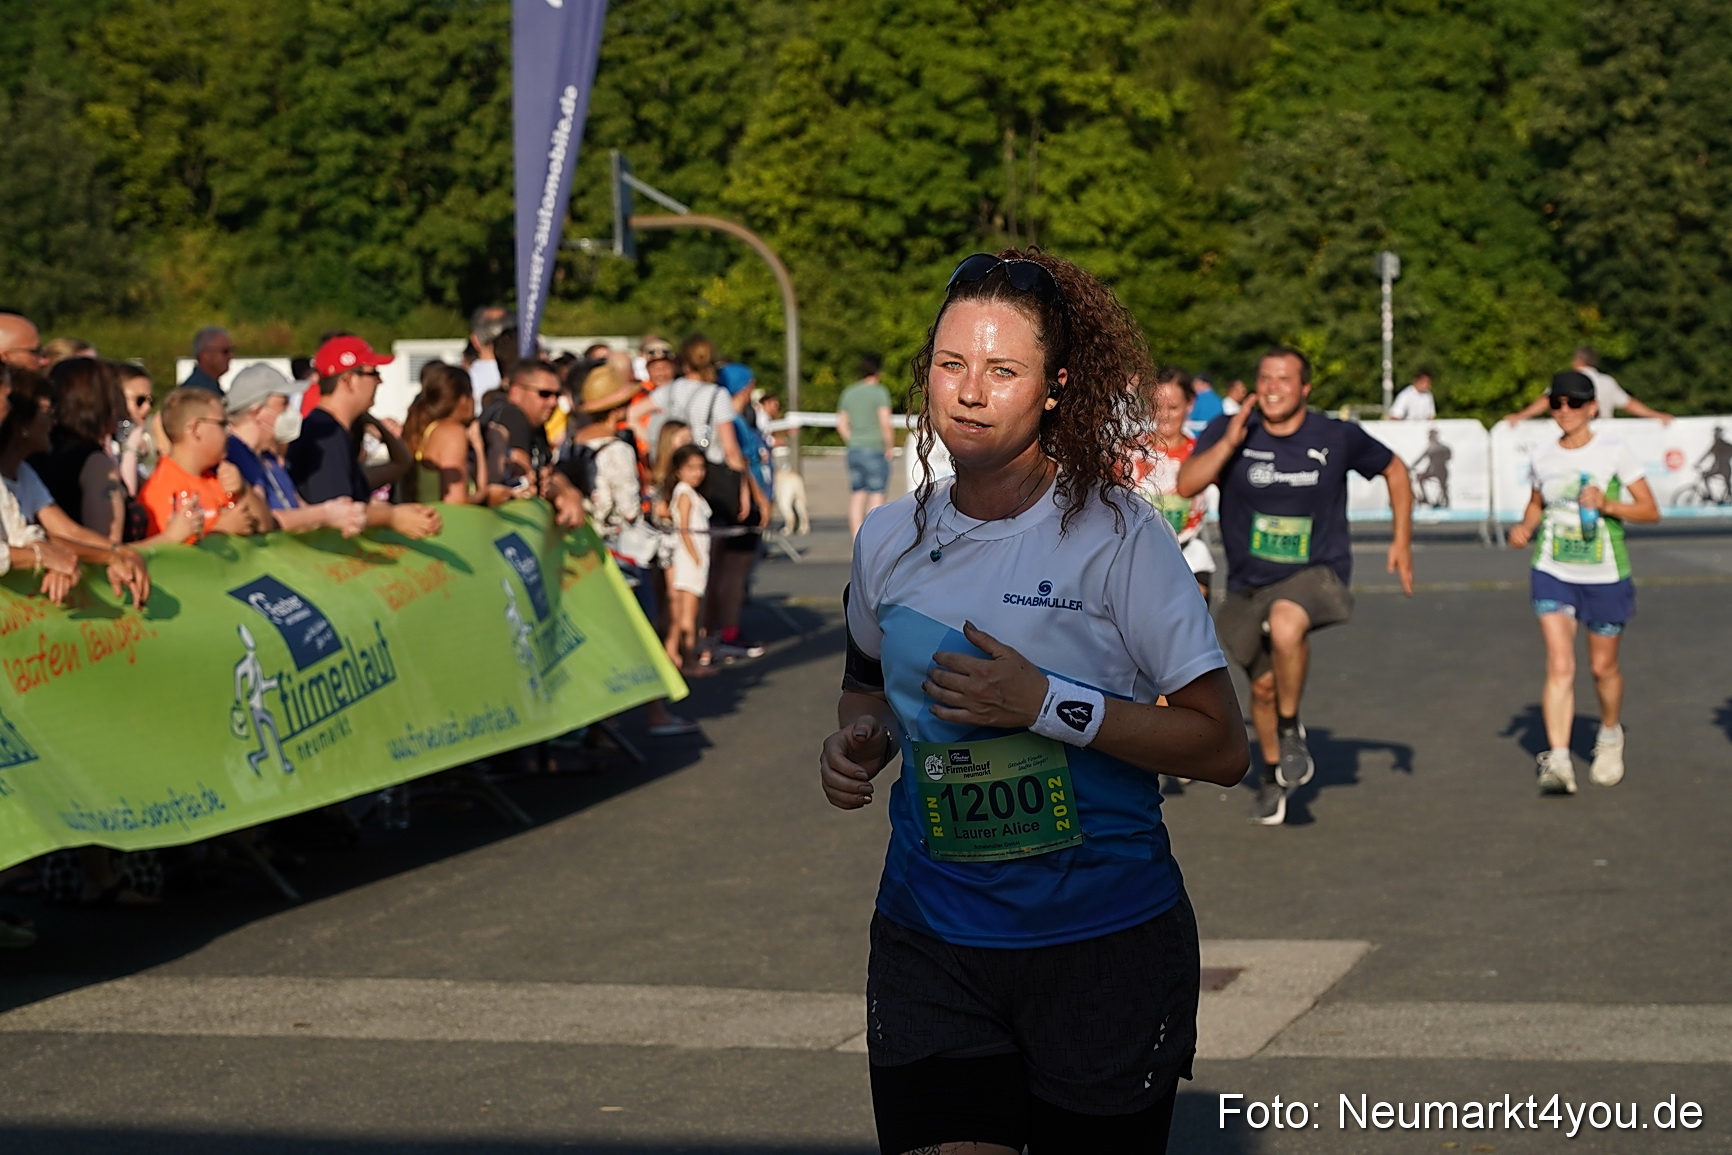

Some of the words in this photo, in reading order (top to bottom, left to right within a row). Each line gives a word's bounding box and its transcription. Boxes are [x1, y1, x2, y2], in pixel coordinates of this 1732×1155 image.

[278, 618, 397, 738] firmenlauf
[945, 761, 990, 775] Firmenlauf
[963, 770, 991, 779] neumarkt
[926, 797, 944, 837] RUN
[940, 775, 1045, 822] 1200
[1047, 775, 1071, 831] 2022
[954, 826, 998, 839] Laurer
[1002, 820, 1040, 837] Alice
